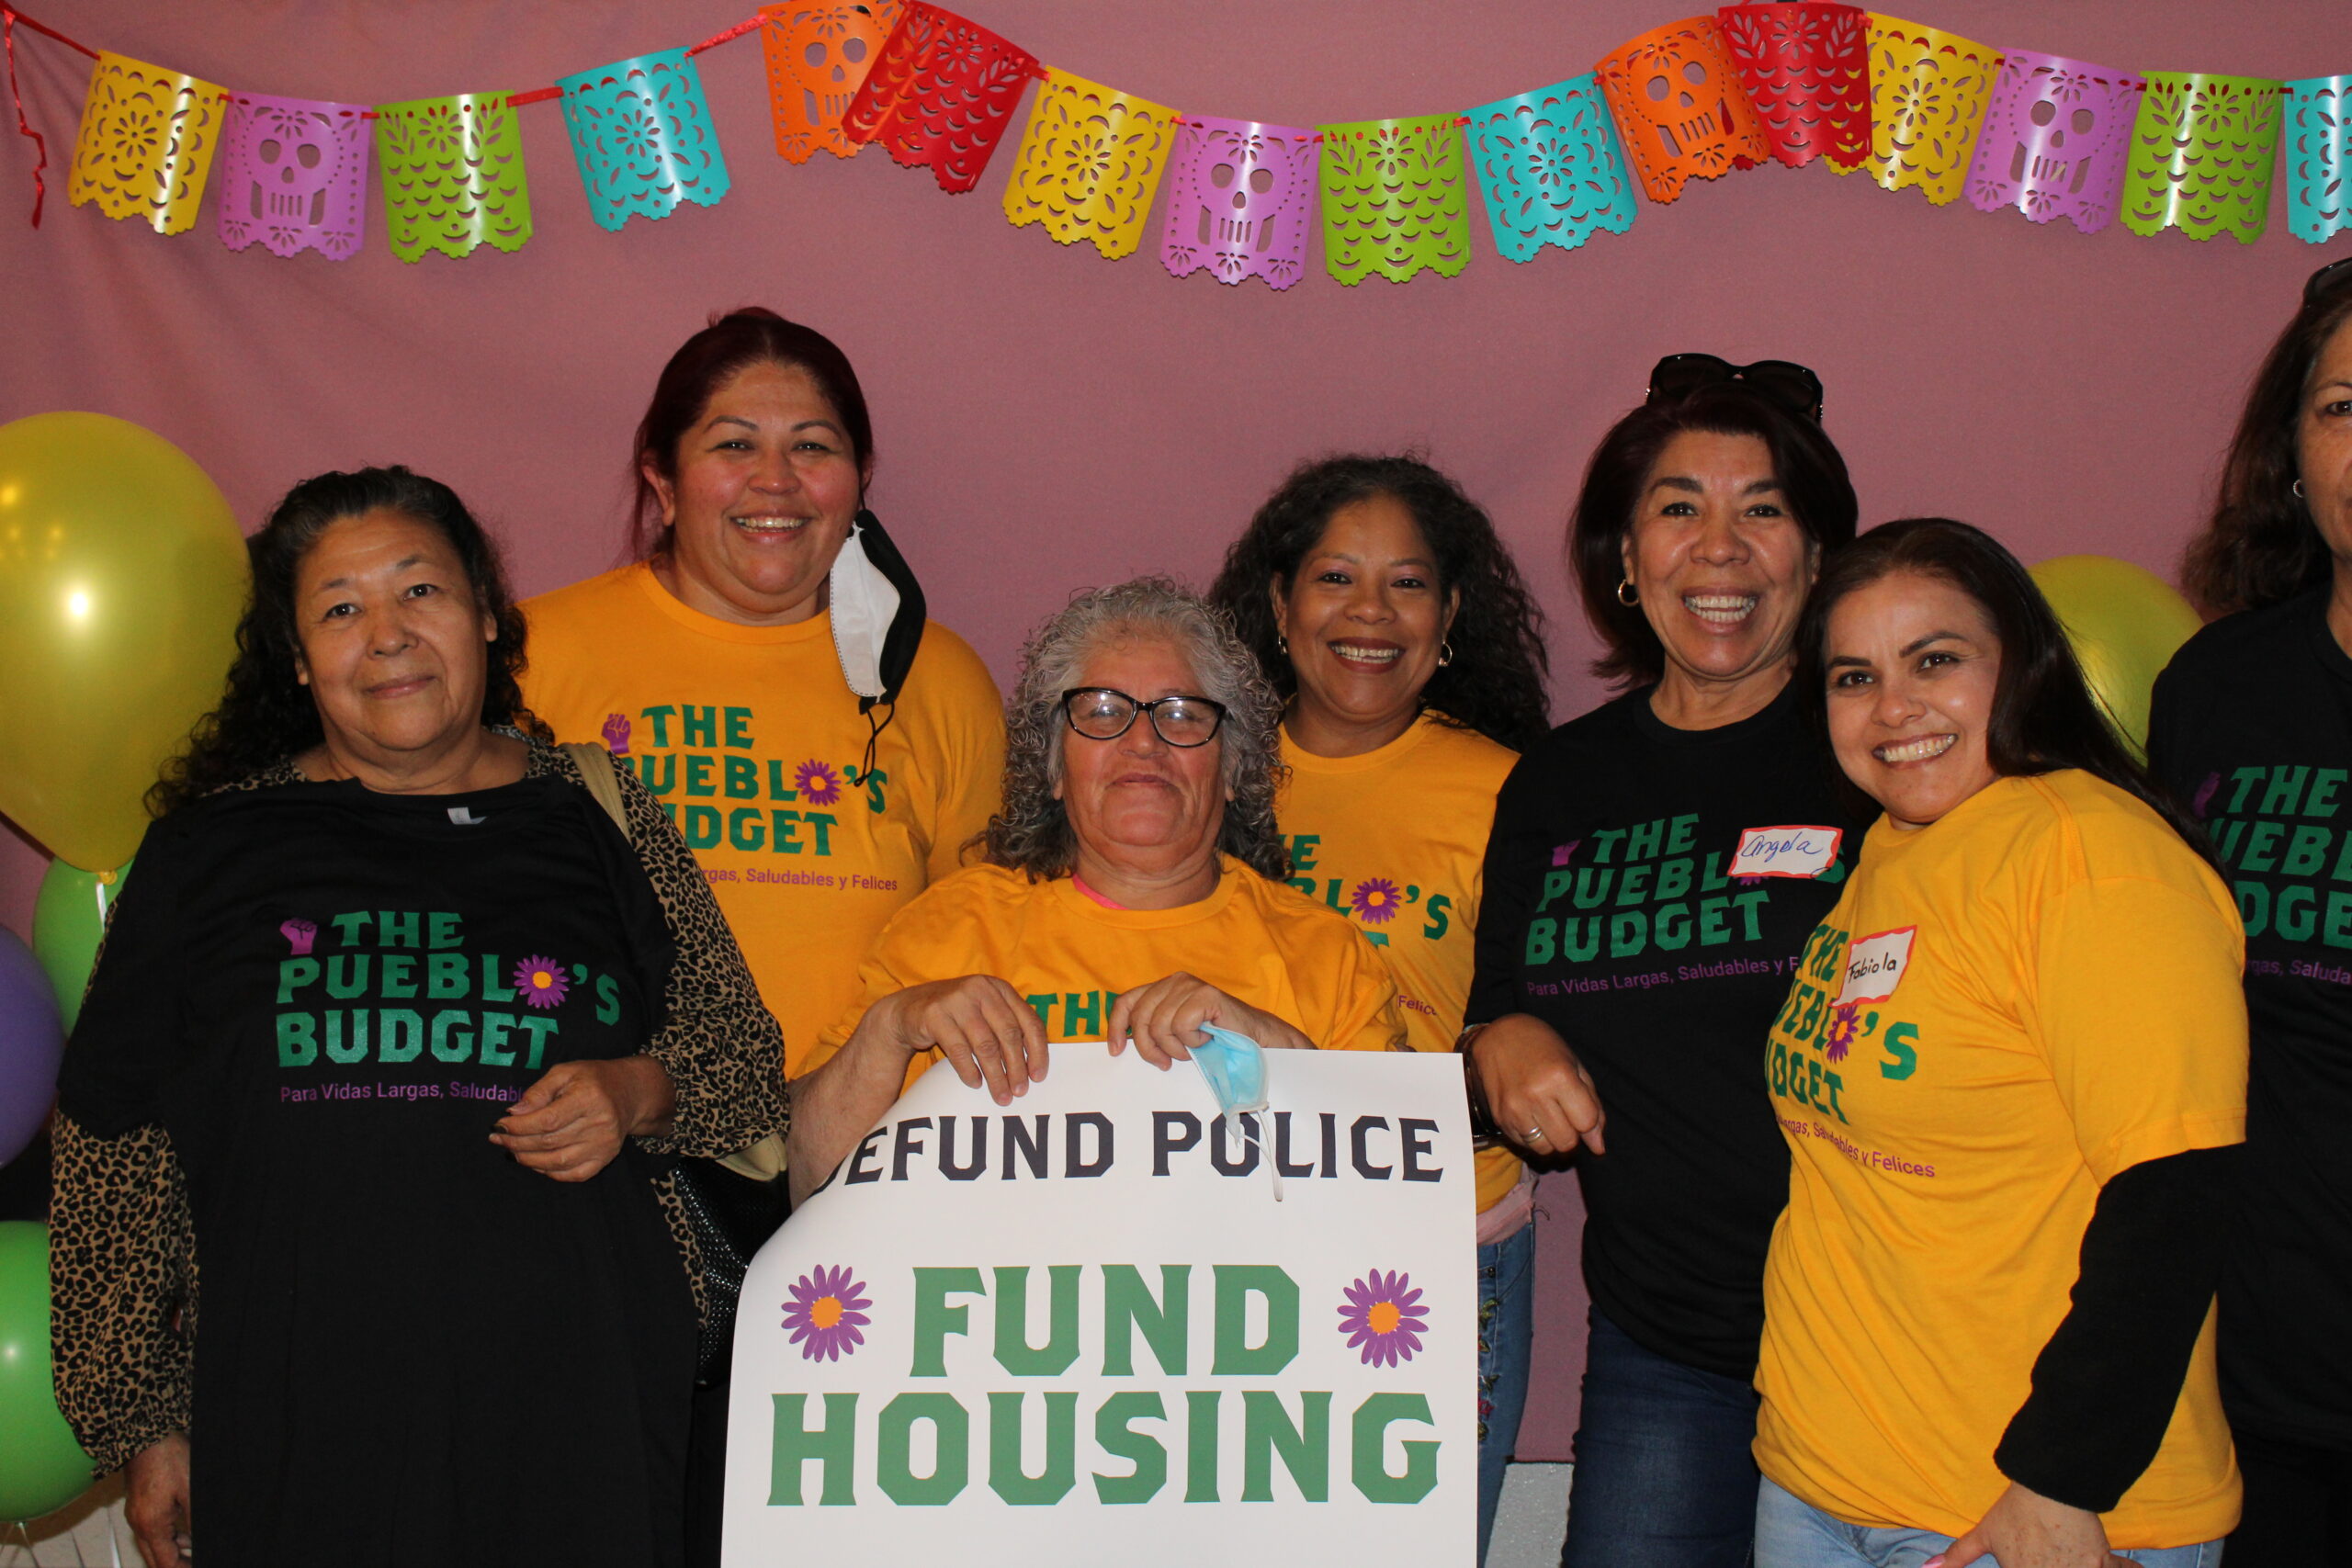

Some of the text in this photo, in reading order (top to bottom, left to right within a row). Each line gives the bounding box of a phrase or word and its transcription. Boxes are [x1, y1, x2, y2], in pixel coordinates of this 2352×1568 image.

[640, 704, 754, 750] THE
[2226, 765, 2348, 818] THE
[662, 802, 838, 856] DGET
[1591, 812, 1700, 864] THE
[745, 867, 834, 887] Saludables
[839, 876, 848, 889] y
[852, 874, 898, 891] Felices
[332, 910, 464, 949] THE
[1524, 889, 1770, 965] BUDGET
[1799, 923, 1849, 983] THE
[1527, 981, 1559, 997] Para
[1562, 977, 1609, 995] Vidas
[1612, 970, 1674, 990] Largas,
[1678, 956, 1770, 982] Saludables
[1773, 960, 1784, 976] y
[1848, 952, 1897, 984] Fabiola
[276, 1008, 560, 1069] BUDGET
[280, 1080, 523, 1103] Para Vidas Largas, Saludabl
[808, 1111, 1444, 1198] EFUND POLICE
[1861, 1150, 1869, 1167] y
[1871, 1151, 1936, 1178] Felices
[909, 1264, 1301, 1377] FUND
[766, 1390, 1442, 1506] HOUSING
